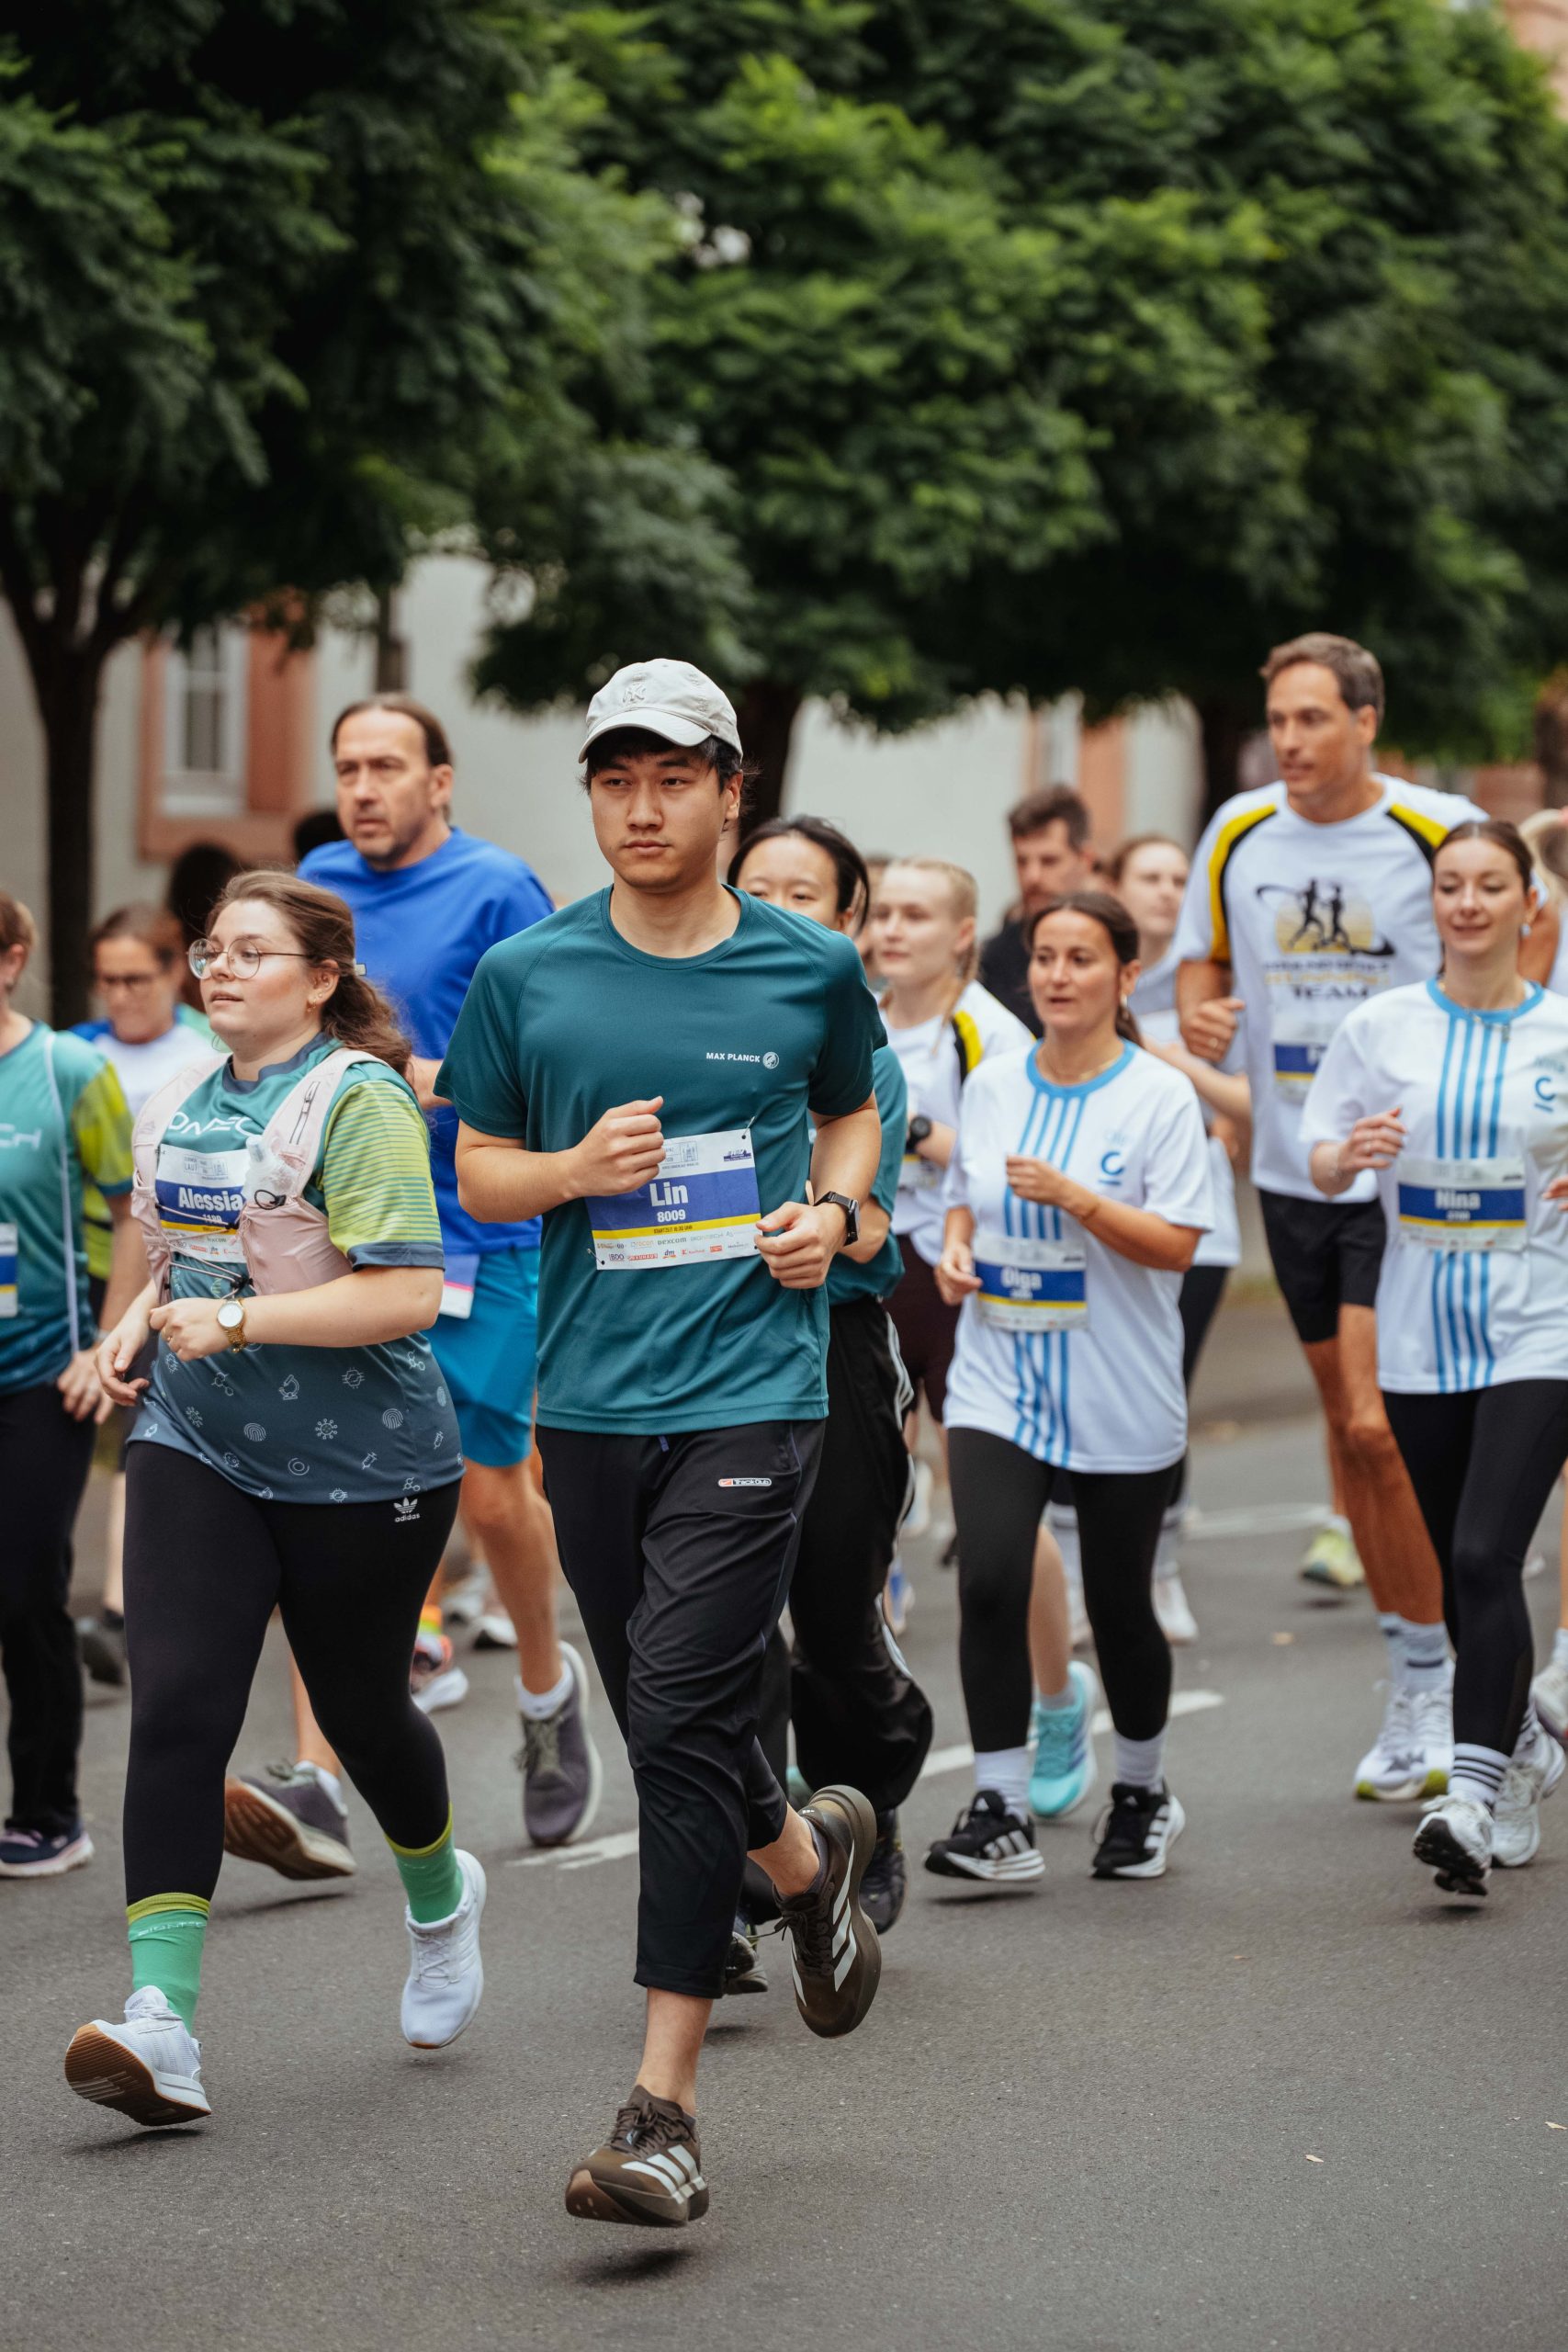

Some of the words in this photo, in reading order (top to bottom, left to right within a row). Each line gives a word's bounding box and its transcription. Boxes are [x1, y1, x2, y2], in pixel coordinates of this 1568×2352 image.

[1294, 987, 1369, 1001] TEAM
[705, 1052, 726, 1060] MAX
[728, 1053, 761, 1063] PLANCK
[178, 1186, 243, 1212] Alessia
[649, 1182, 689, 1207] Lin
[1435, 1188, 1481, 1210] Nina
[657, 1209, 686, 1223] 8009
[1001, 1267, 1043, 1292] Olga
[395, 1513, 421, 1522] adidas
